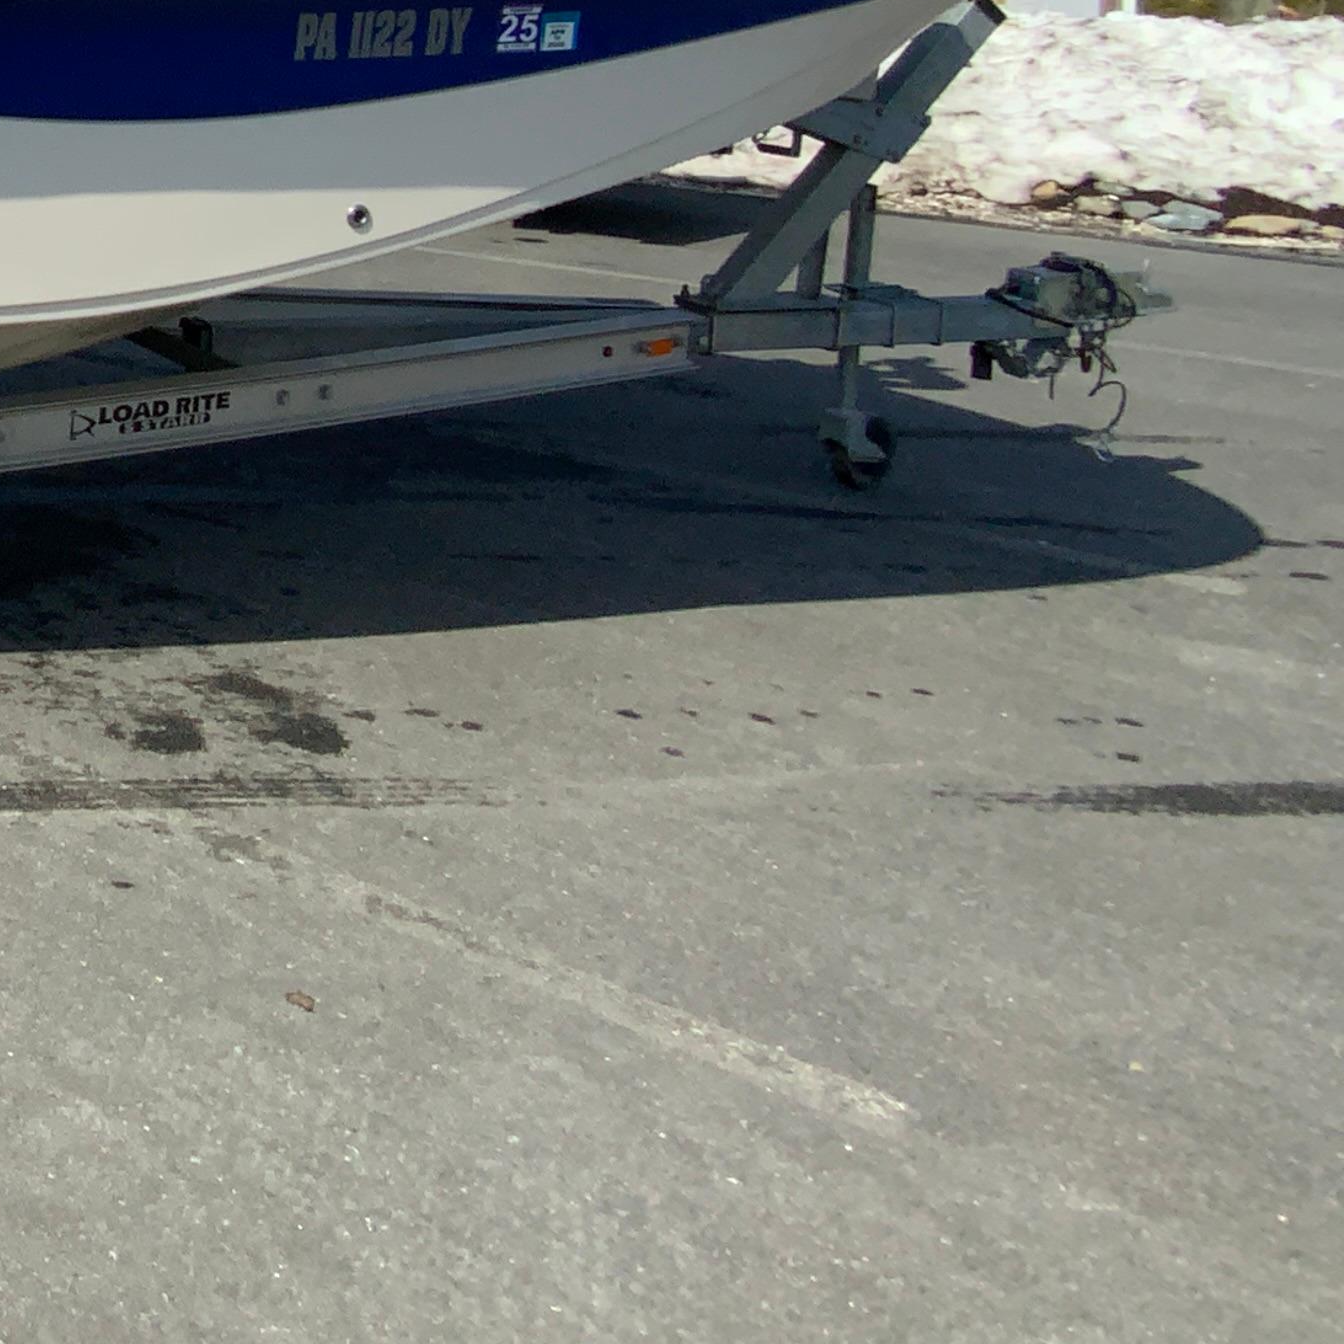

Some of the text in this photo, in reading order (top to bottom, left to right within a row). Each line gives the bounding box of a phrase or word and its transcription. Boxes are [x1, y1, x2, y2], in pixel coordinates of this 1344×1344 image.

[294, 7, 474, 61] PA 1122 DY
[497, 14, 540, 43] 25
[98, 399, 170, 425] LOAD
[175, 391, 232, 415] RITE
